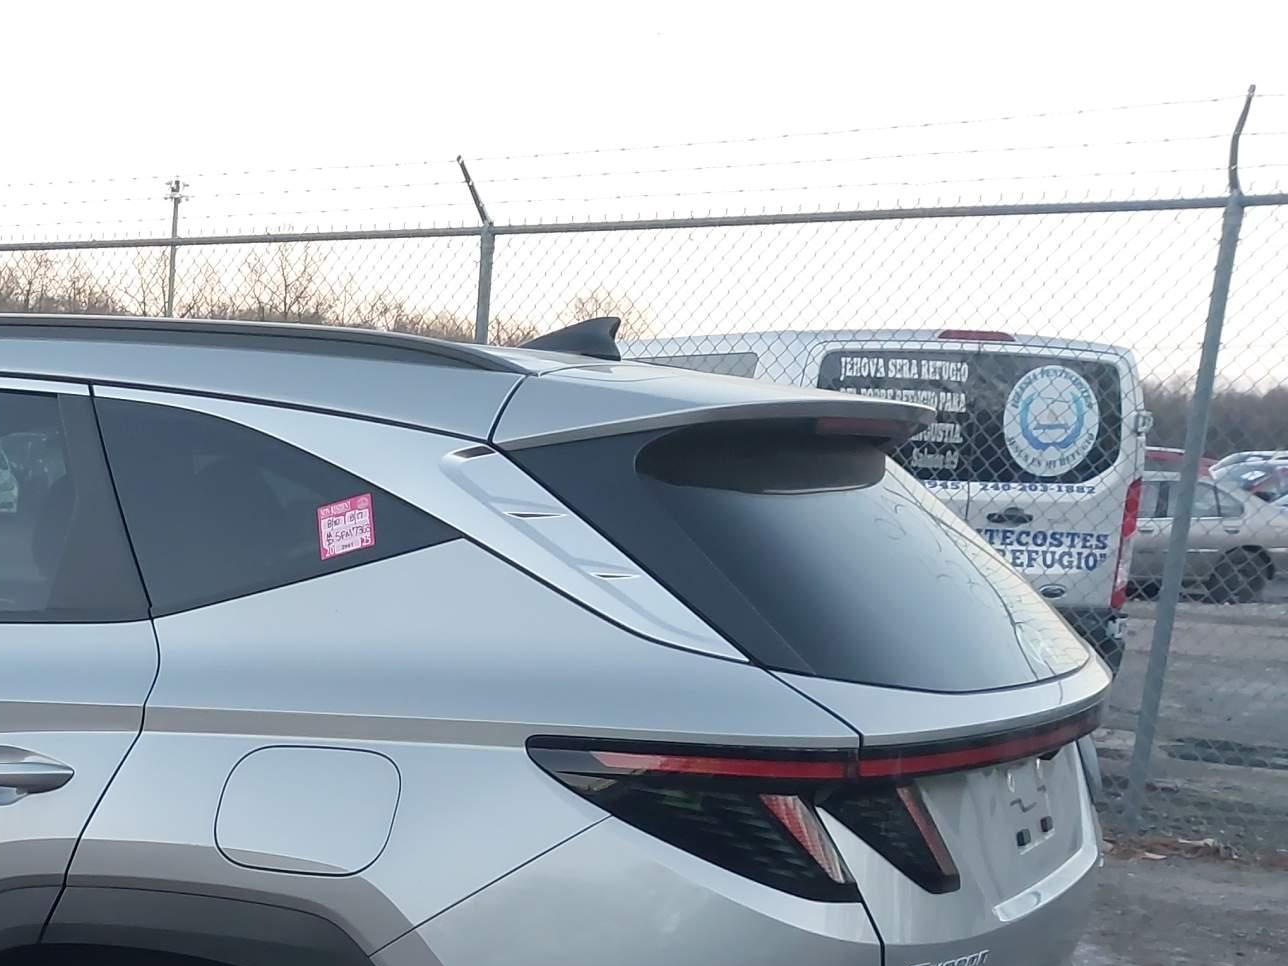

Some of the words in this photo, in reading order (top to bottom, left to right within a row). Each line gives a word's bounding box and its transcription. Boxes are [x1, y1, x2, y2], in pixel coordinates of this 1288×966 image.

[839, 357, 885, 381] JEHOVA
[888, 358, 918, 379] SERA
[921, 360, 969, 382] REFUGIO
[938, 391, 967, 412] PARA
[975, 528, 1110, 550] TECOSTES
